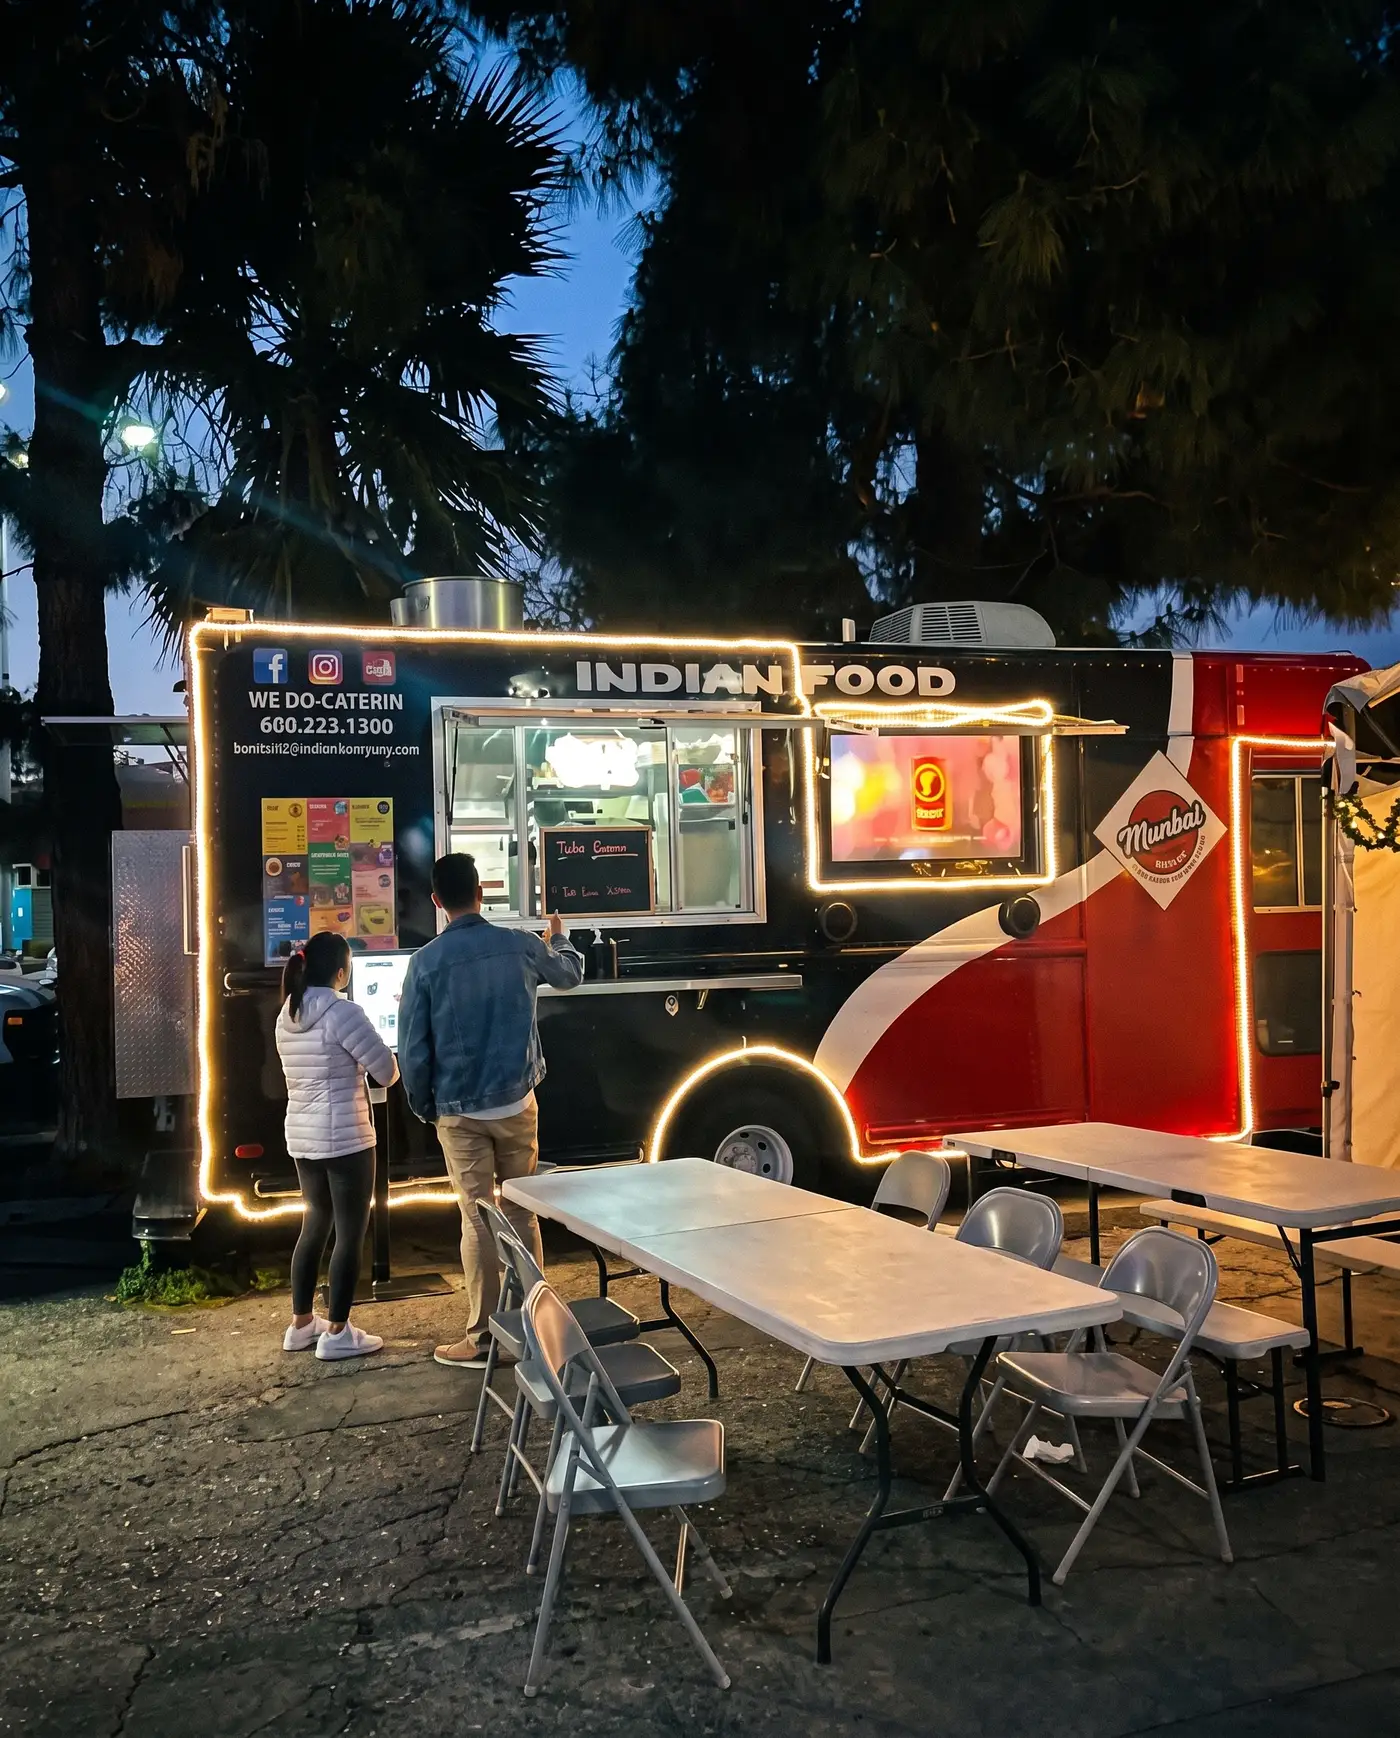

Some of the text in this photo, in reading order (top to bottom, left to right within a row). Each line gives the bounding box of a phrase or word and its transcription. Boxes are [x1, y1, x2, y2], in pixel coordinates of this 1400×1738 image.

[575, 661, 956, 696] INDIAN FOOD
[248, 691, 403, 710] WE DO-CATERIN
